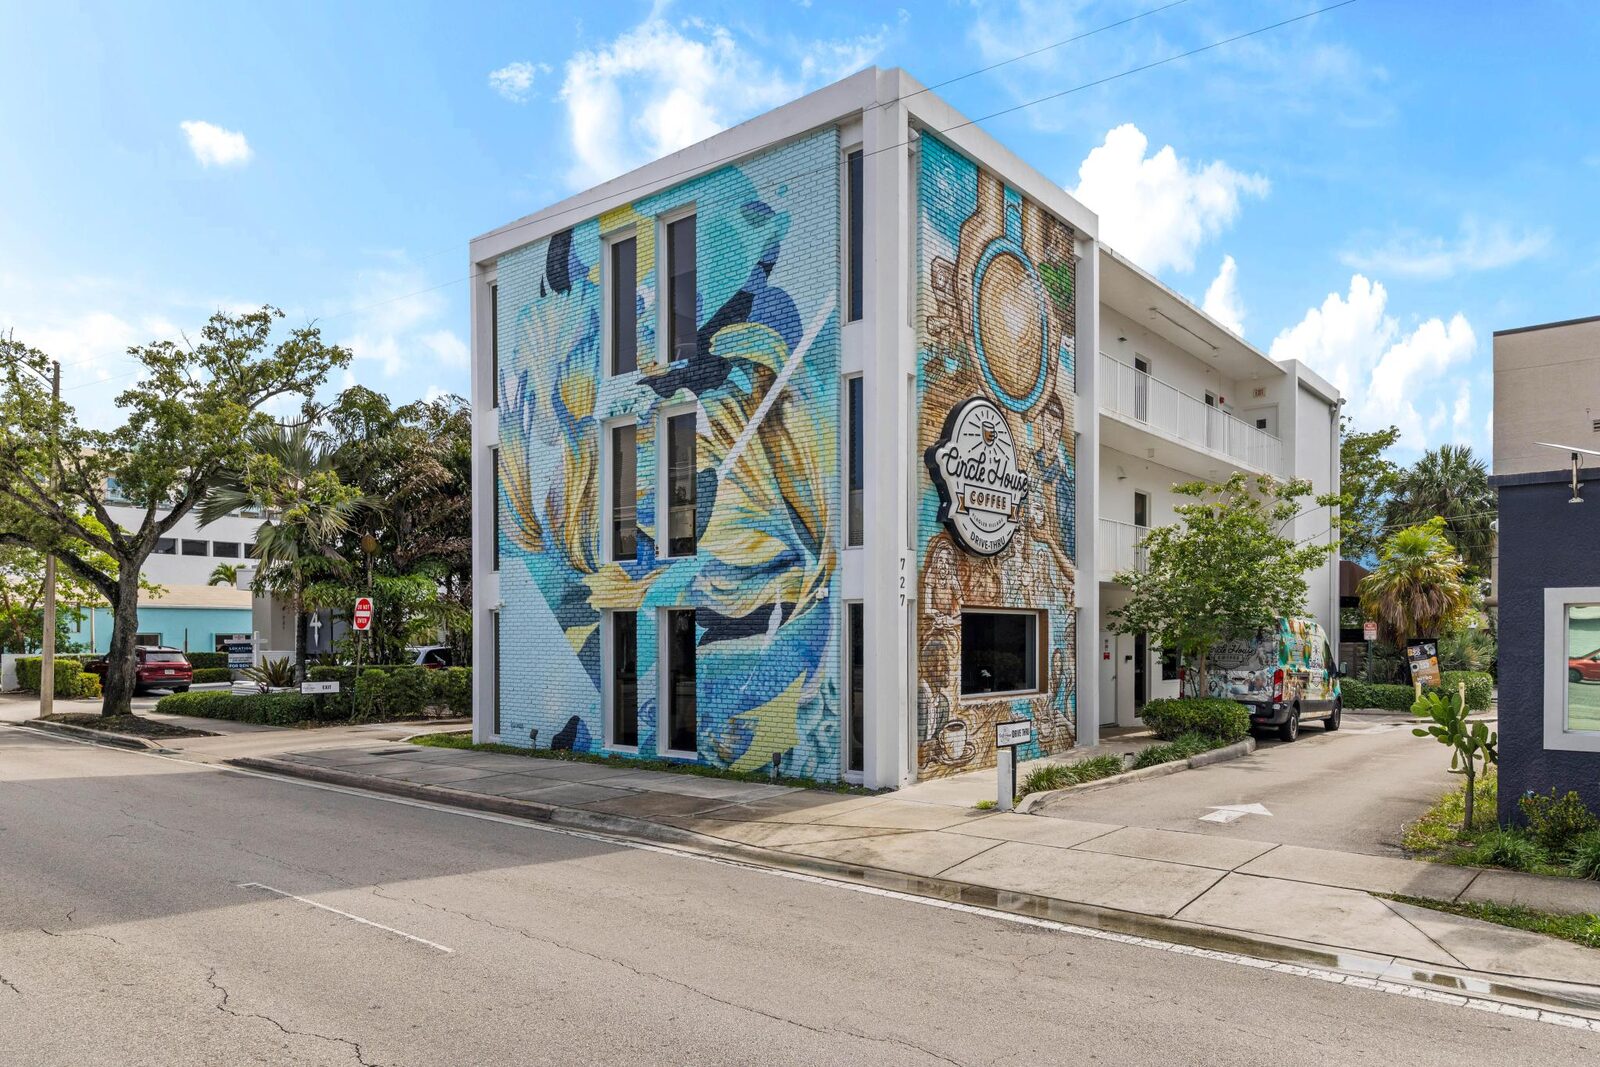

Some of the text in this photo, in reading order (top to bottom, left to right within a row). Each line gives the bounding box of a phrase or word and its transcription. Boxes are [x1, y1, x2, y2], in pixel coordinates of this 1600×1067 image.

[941, 446, 1029, 494] Circle House
[970, 490, 1007, 510] COFFEE
[970, 531, 1006, 550] DRIVE-THRU
